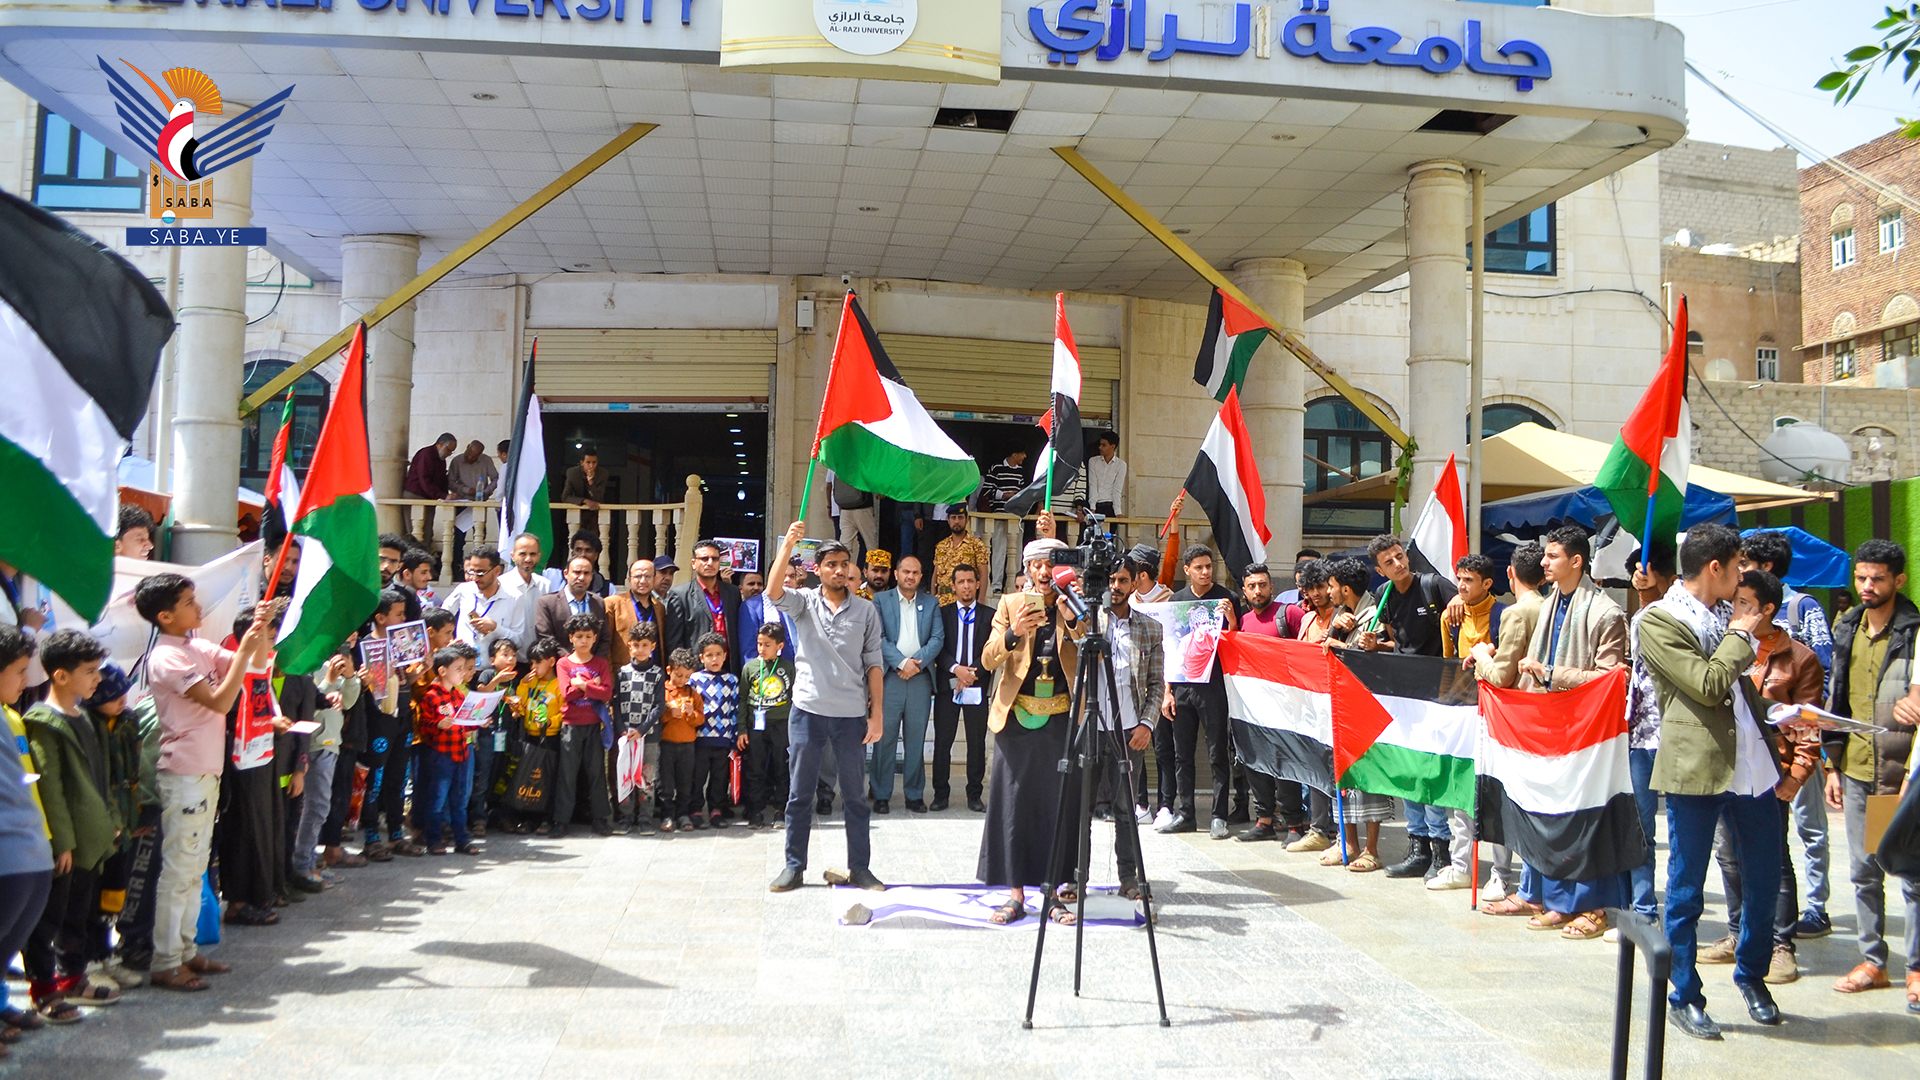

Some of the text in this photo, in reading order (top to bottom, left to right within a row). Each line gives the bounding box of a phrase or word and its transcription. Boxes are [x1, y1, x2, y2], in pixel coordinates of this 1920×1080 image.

[828, 11, 904, 25] جامعة الرازي
[861, 27, 904, 35] UNIVERSITY
[1281, 0, 1552, 92] جامعة
